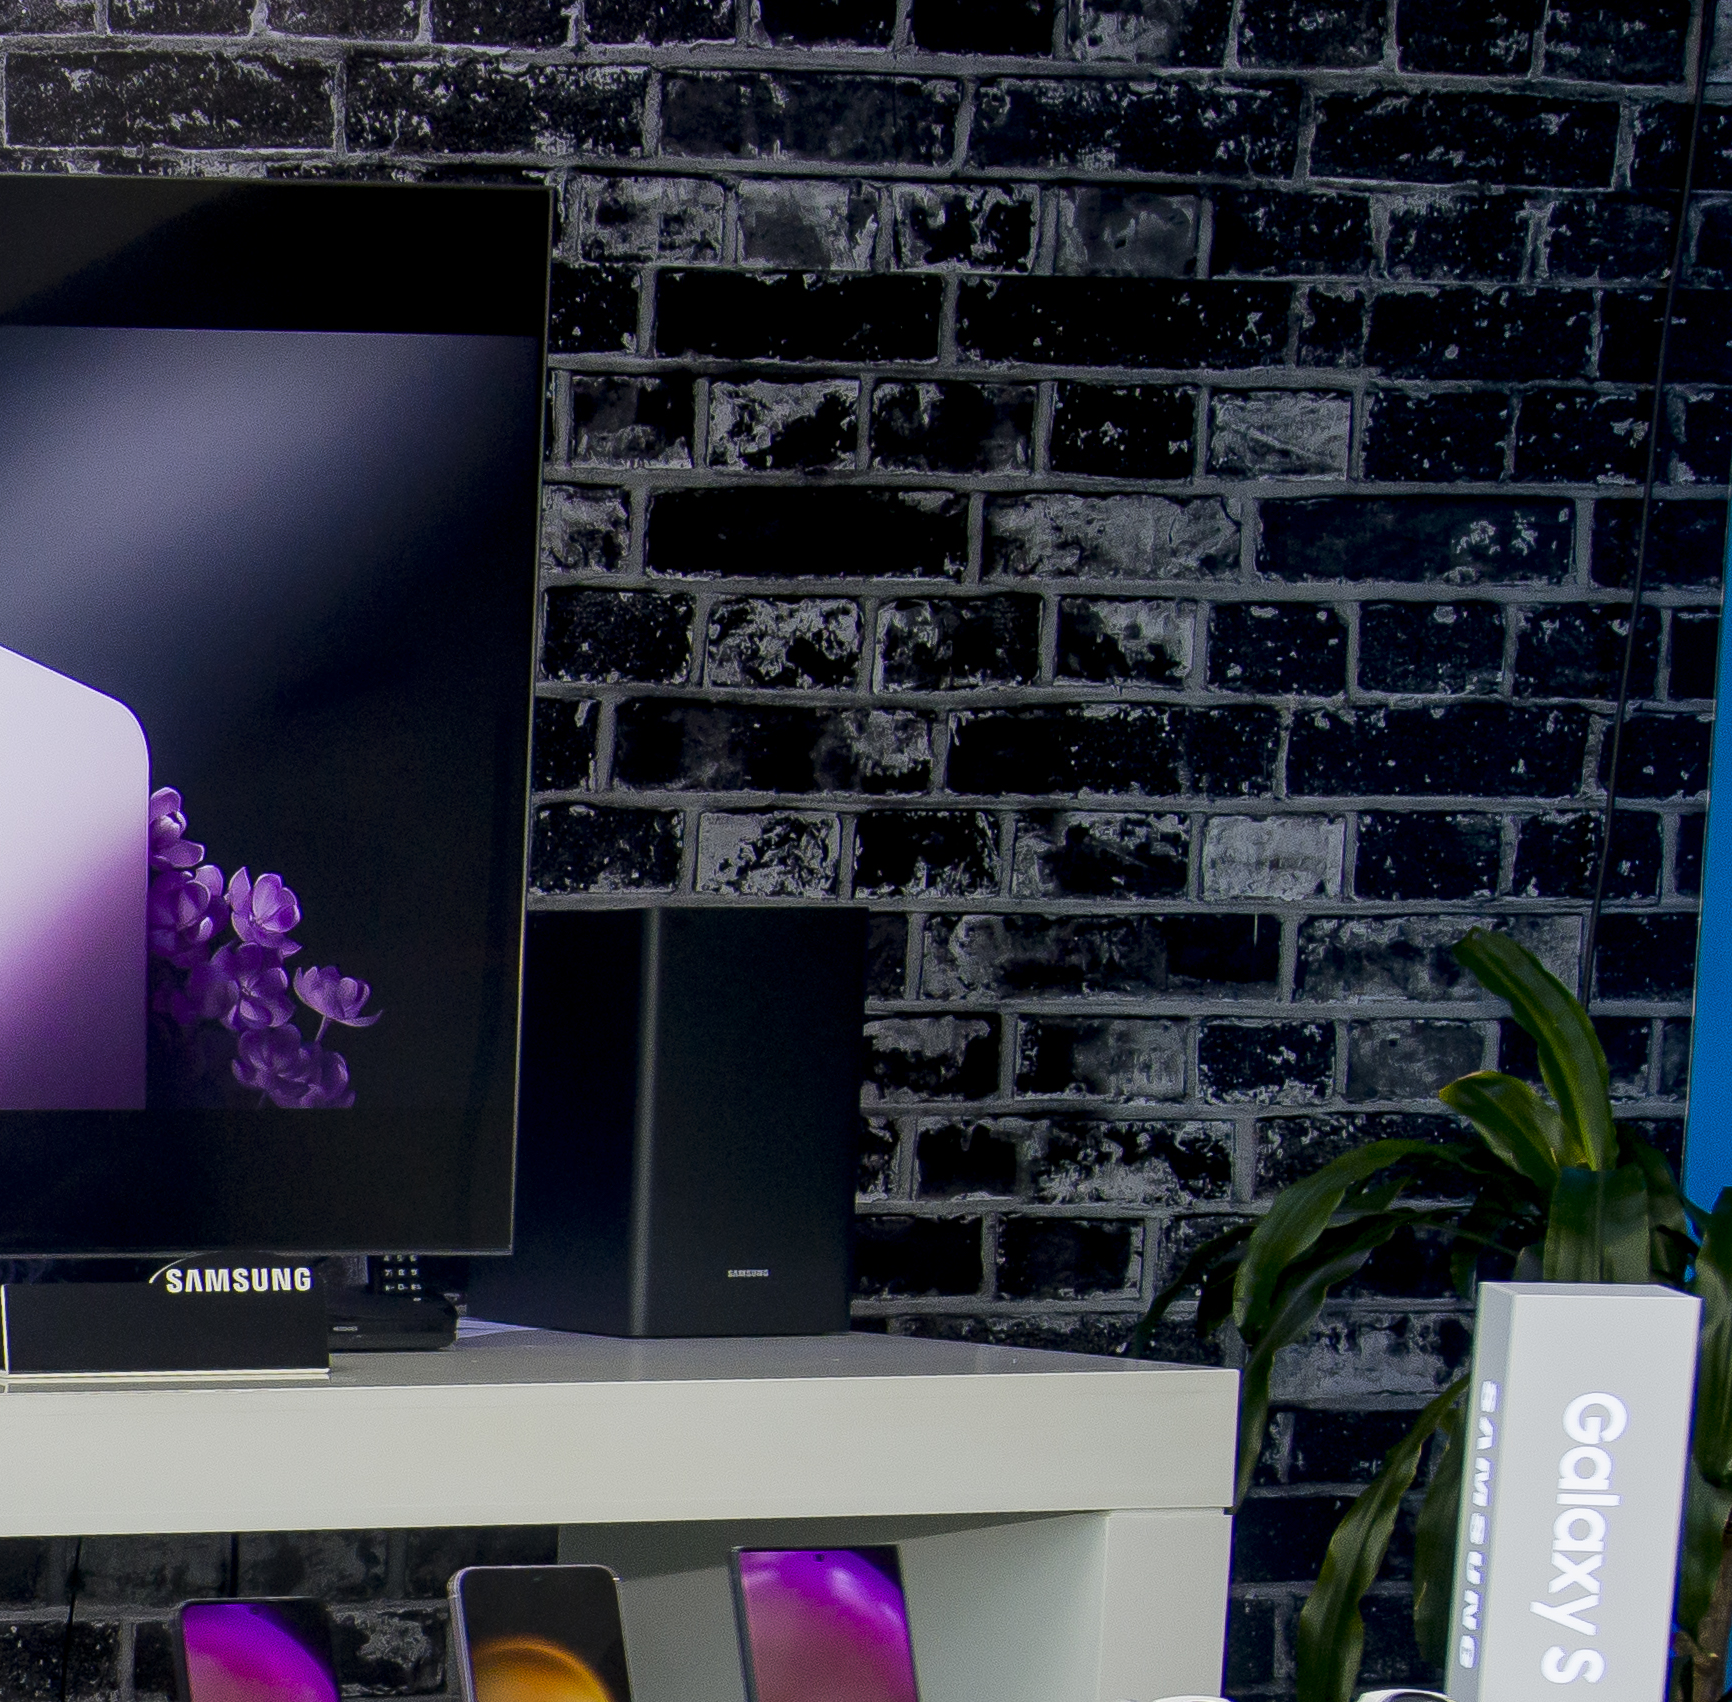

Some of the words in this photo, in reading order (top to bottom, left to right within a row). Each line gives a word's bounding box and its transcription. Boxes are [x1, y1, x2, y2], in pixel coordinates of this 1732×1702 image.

[165, 1267, 312, 1293] SAMSUNG
[1529, 1391, 1630, 1636] Galaxy
[1540, 1645, 1607, 1684] S
